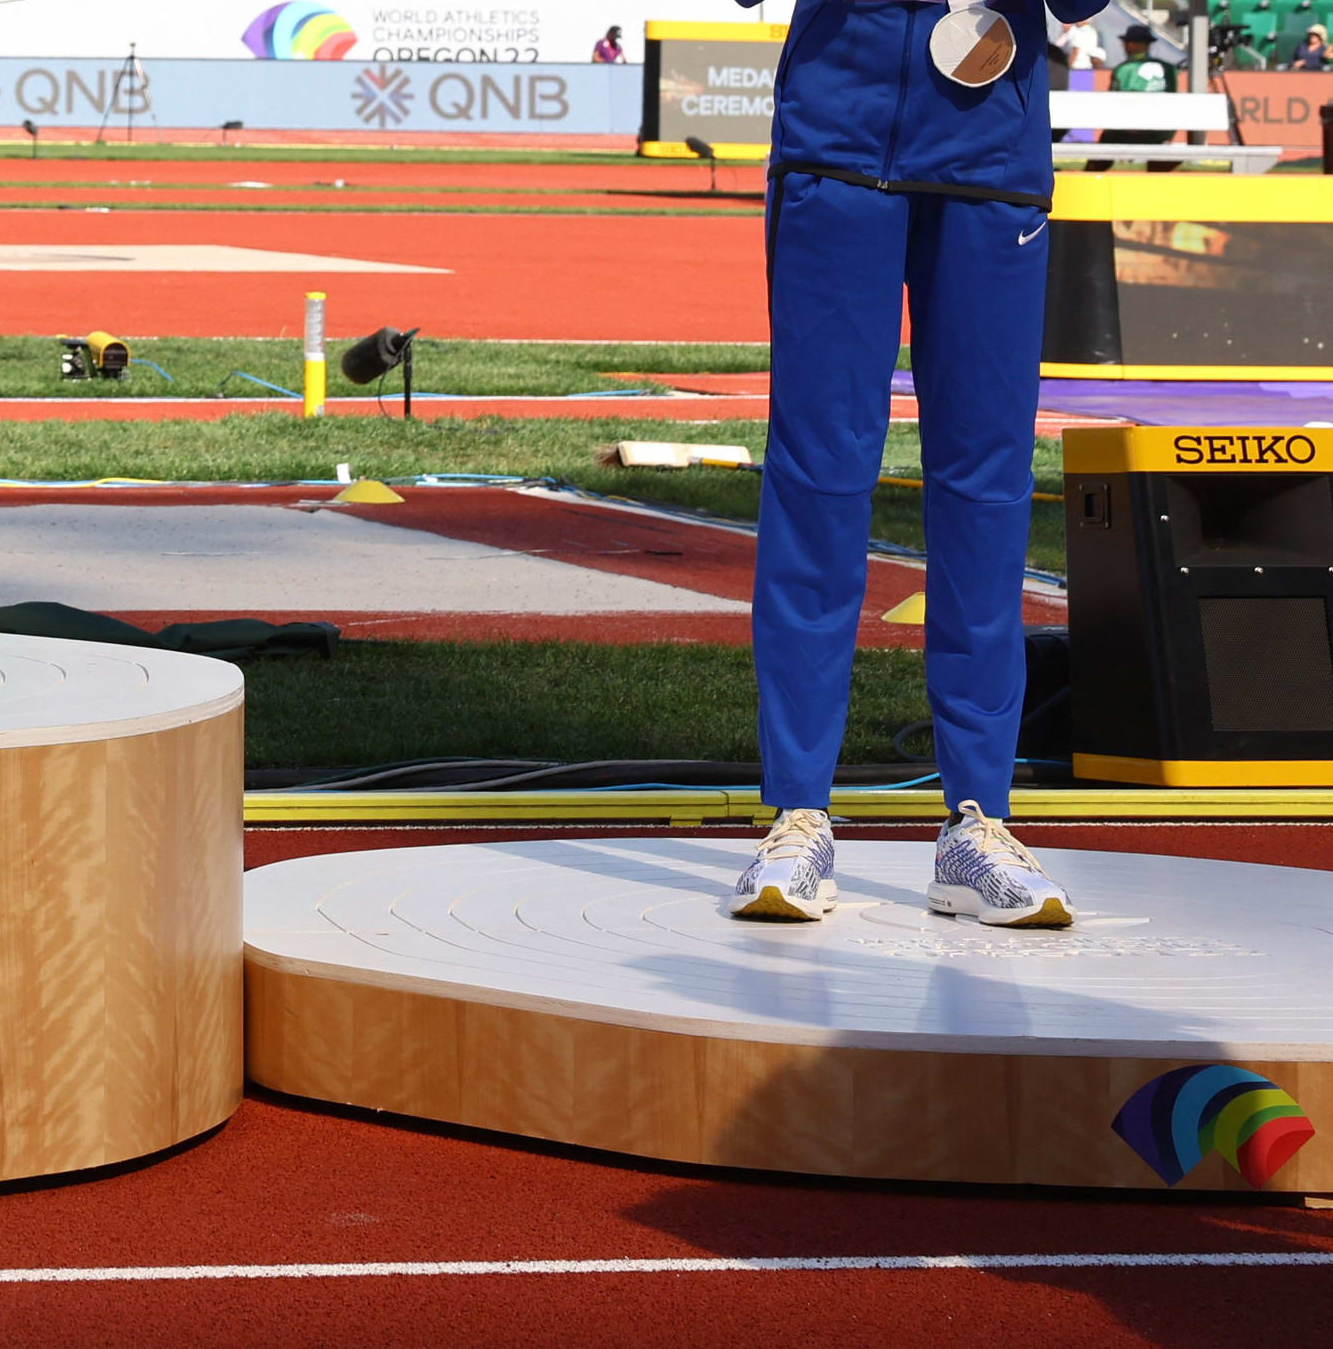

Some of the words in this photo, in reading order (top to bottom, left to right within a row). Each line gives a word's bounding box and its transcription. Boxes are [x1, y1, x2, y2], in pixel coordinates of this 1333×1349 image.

[373, 10, 437, 24] WORLD
[445, 10, 540, 25] ATHLETICS
[373, 27, 540, 43] CHAMPIONSHIPS
[708, 65, 774, 88] MEDA
[15, 68, 150, 116] QNB
[429, 72, 569, 121] QNB
[681, 94, 775, 117] CEREMO
[1238, 96, 1311, 124] RLD
[1175, 435, 1316, 464] SEIKO
